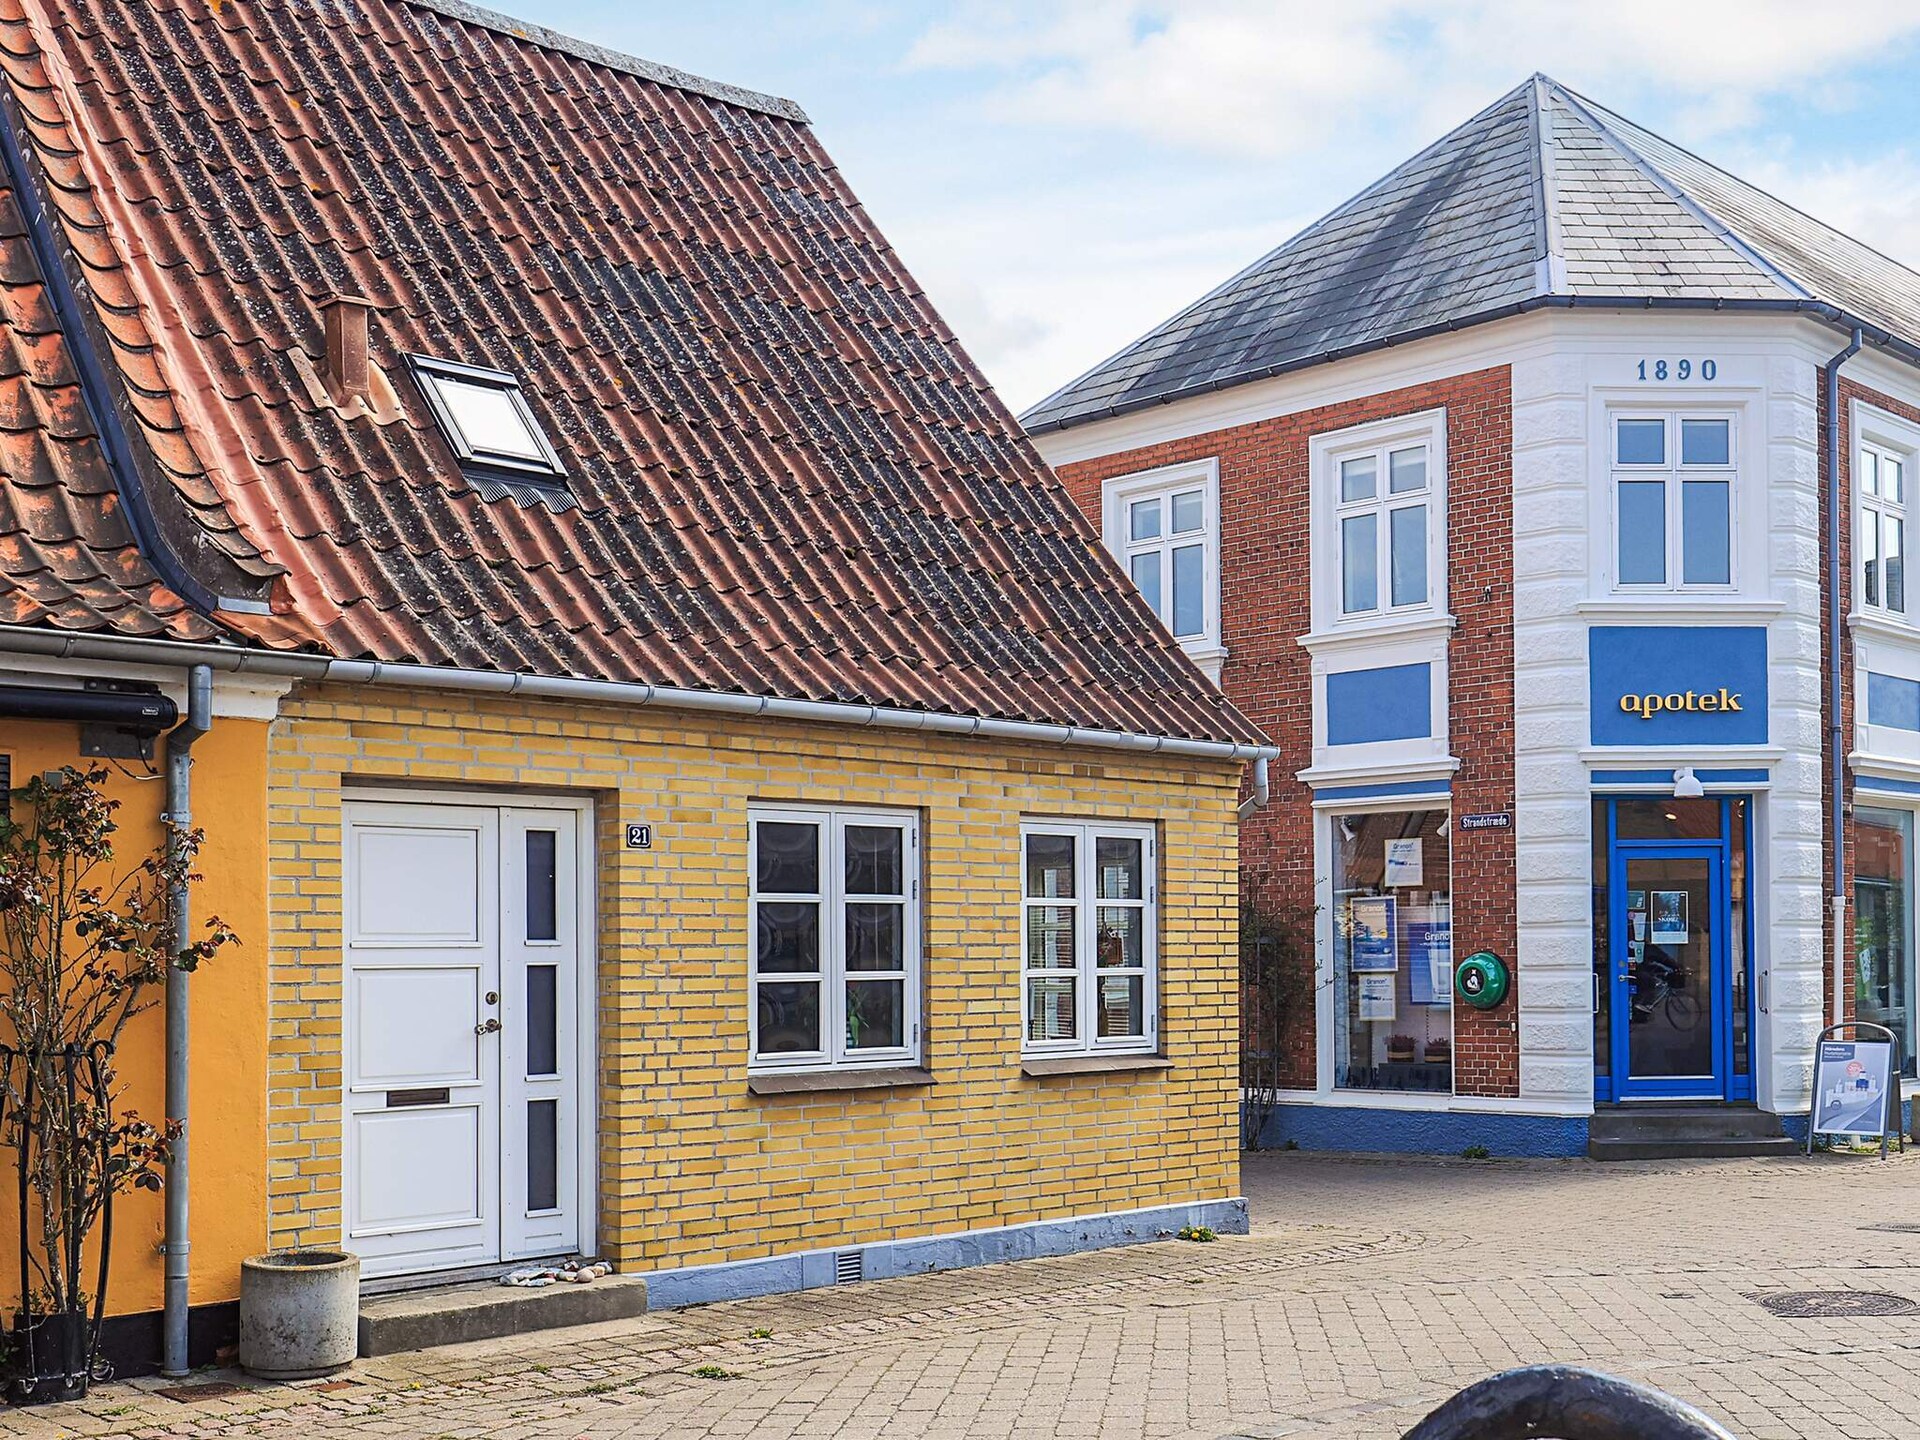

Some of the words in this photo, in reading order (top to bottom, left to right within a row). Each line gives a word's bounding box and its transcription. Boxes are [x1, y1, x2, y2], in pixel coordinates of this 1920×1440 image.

[1637, 358, 1717, 381] 1890
[1619, 688, 1743, 719] apotek
[1462, 816, 1508, 828] Strandstræde
[631, 828, 648, 844] 21
